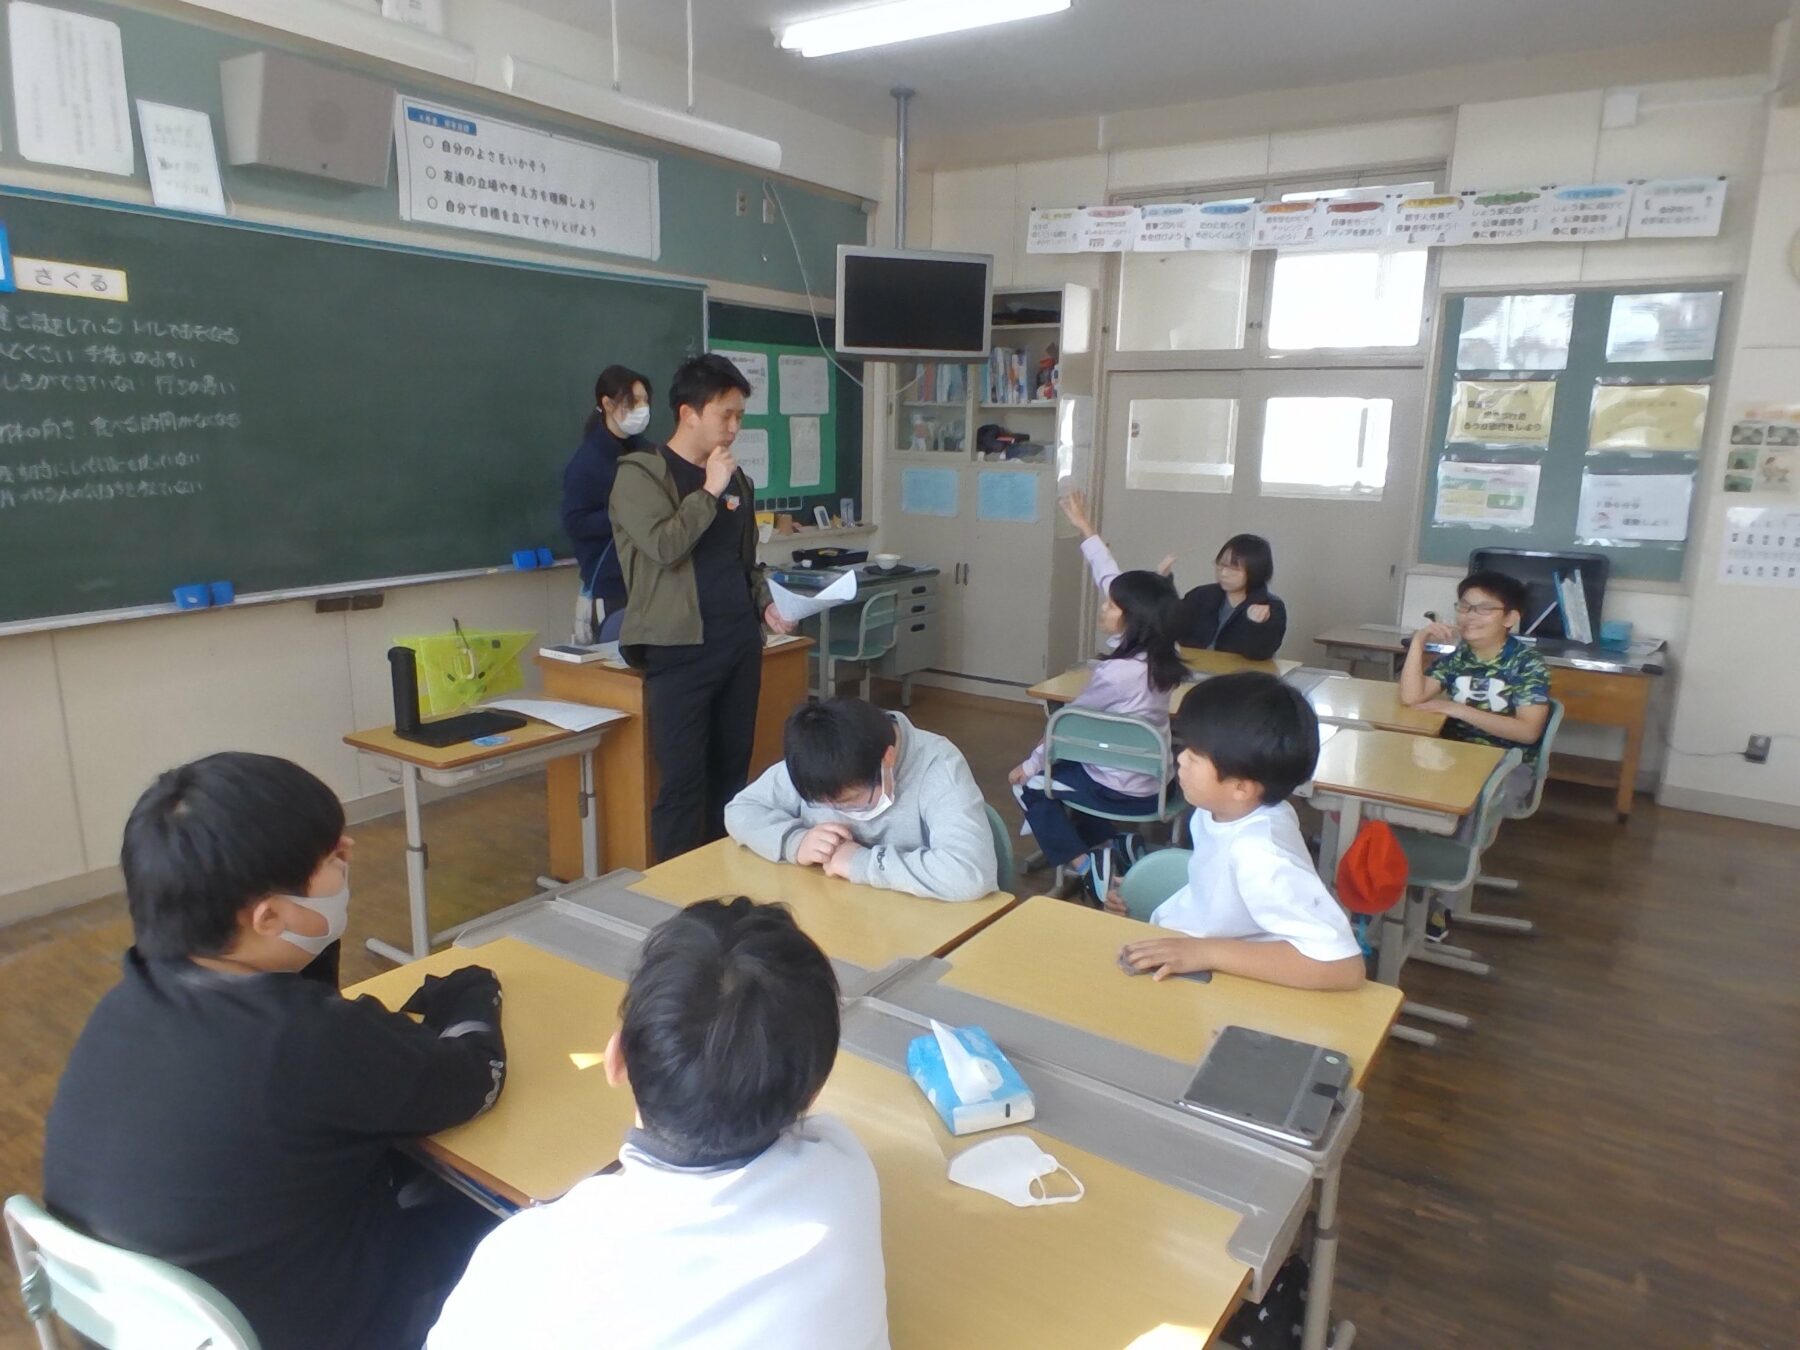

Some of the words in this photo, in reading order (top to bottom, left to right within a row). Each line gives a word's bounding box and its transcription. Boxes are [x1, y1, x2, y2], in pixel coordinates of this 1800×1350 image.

[442, 140, 546, 173] 自分のよさをいかそう
[443, 169, 596, 211] 友達の立場や考え方を理解しよう
[33, 267, 109, 293] さぐる
